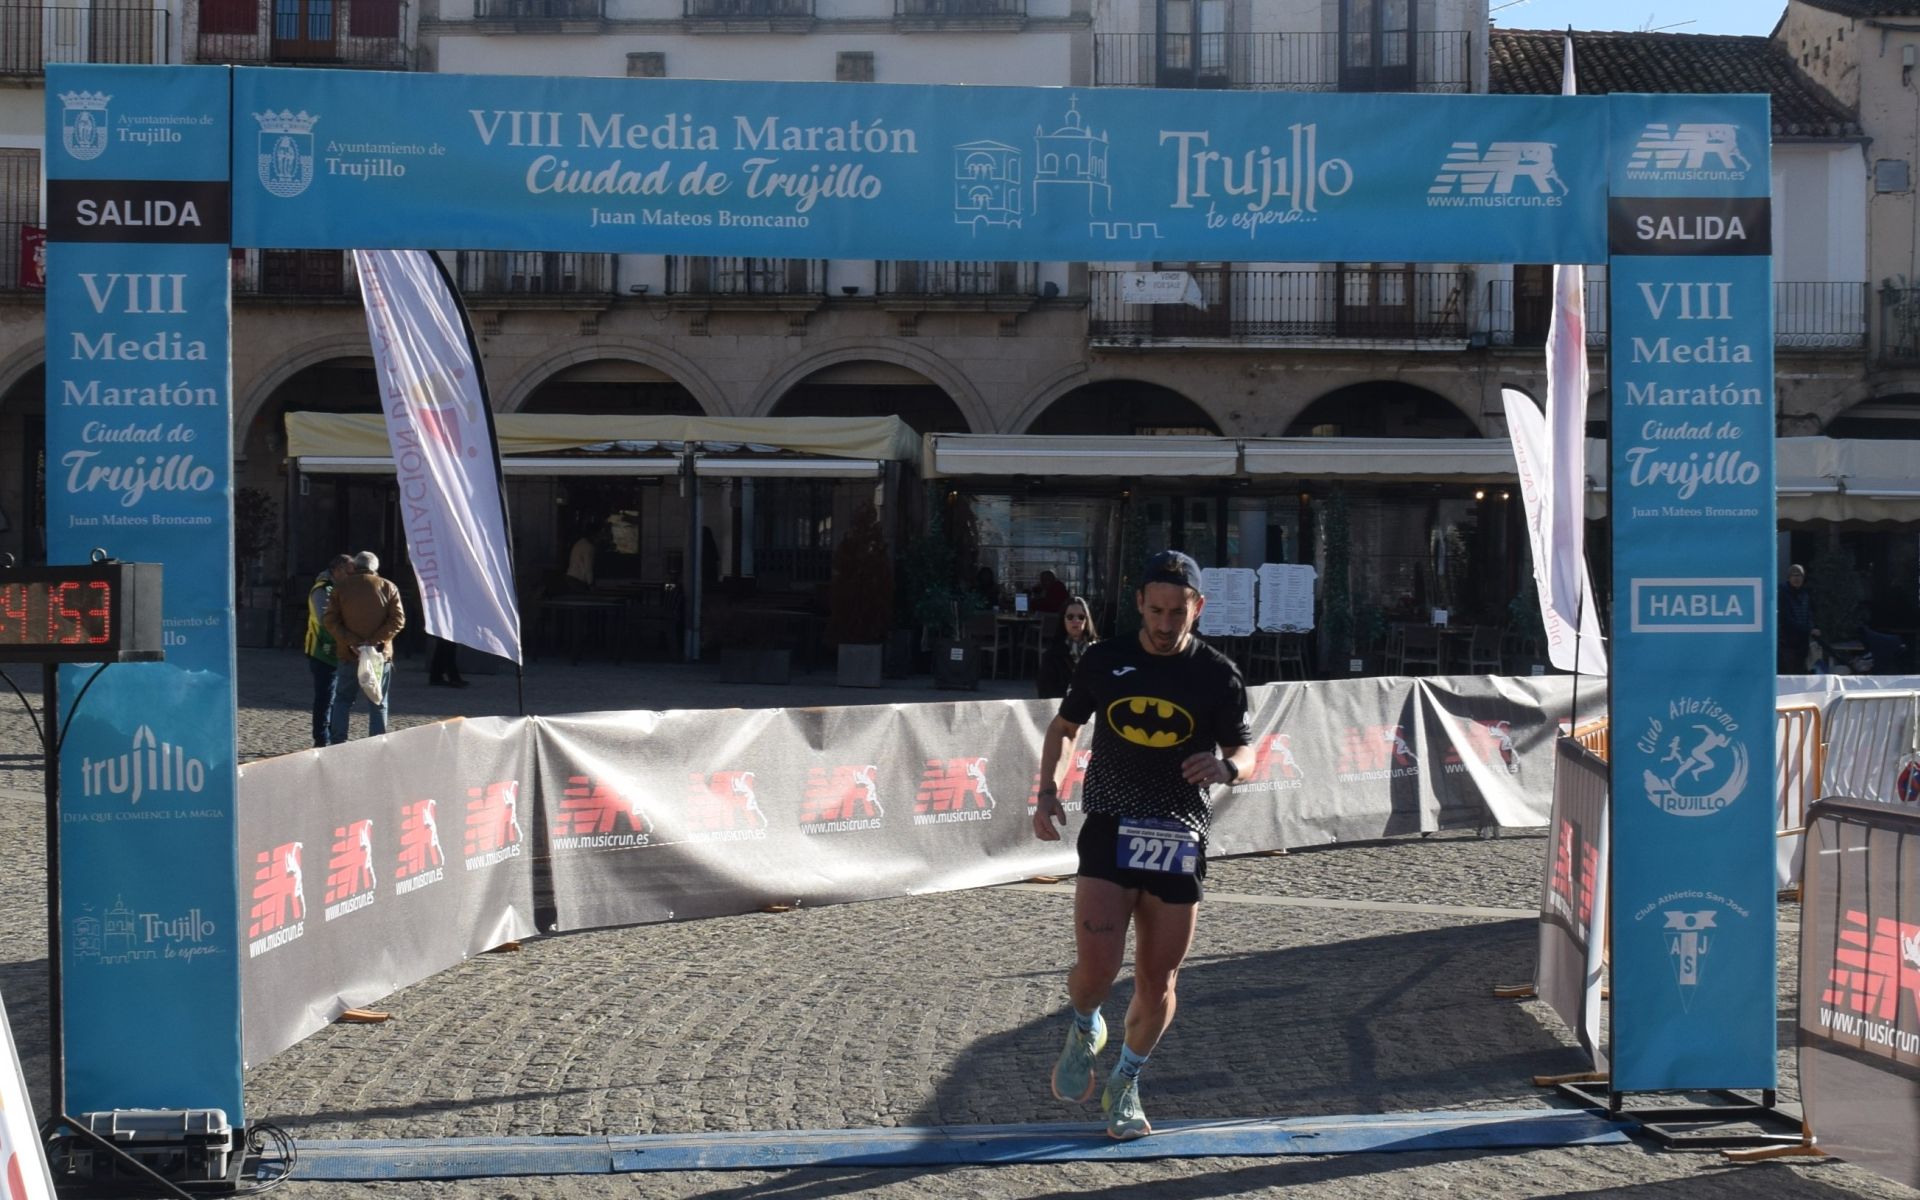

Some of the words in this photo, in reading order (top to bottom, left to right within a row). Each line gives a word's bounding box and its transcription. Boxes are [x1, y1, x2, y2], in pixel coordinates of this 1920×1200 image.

[118, 114, 197, 127] Ayuntamiento
[199, 114, 214, 125] de
[468, 109, 563, 148] VIII
[577, 112, 720, 151] Media
[733, 115, 919, 154] Maratón
[116, 127, 182, 146] Trujillo
[327, 140, 426, 156] Ayuntamiento
[428, 142, 446, 155] de
[325, 157, 406, 181] Trujillo
[1159, 122, 1354, 214] Trujillo
[1626, 169, 1745, 182] www.musicrun.es
[526, 154, 672, 196] Ciudad
[678, 161, 733, 197] de
[741, 157, 883, 213] Trujillo
[76, 199, 201, 228] SALIDA
[1426, 194, 1562, 207] www.musicrun.es
[589, 207, 636, 228] Juan
[642, 207, 712, 227] Mateos
[718, 208, 810, 228] Broncano
[1205, 200, 1228, 229] te
[1635, 215, 1747, 240] SALIDA
[77, 273, 188, 314] VIII
[1637, 282, 1733, 320] VIII
[71, 331, 208, 361] Media
[1631, 337, 1753, 364] Media
[61, 379, 219, 406] Maratón
[1624, 381, 1763, 406] Maratón
[81, 421, 163, 444] Ciudad
[167, 423, 196, 443] de
[1641, 420, 1712, 441] Ciudad
[1716, 422, 1742, 440] de
[61, 450, 215, 508] Trujillo
[1625, 446, 1760, 500] Trujillo
[68, 515, 99, 528] Juan
[102, 514, 148, 526] Mateos
[152, 514, 212, 526] Broncano
[1631, 507, 1659, 519] Juan
[1661, 506, 1702, 517] Mateos
[1705, 506, 1759, 517] Broncano
[1650, 594, 1743, 617] HABLA
[205, 615, 220, 626] de
[1637, 717, 1664, 754] Club
[1669, 696, 1739, 732] Atletismo
[82, 724, 205, 805] trujillo
[1337, 765, 1419, 783] www.musicrun.es
[174, 810, 188, 819] LA
[800, 818, 881, 836] www.musicrun.es
[913, 808, 992, 826] www.musicrun.es
[552, 832, 649, 850] www.musicrun.es
[465, 843, 521, 872] www.musicrun.es
[1128, 837, 1180, 872] 227
[396, 867, 444, 896] www.musicrun.es
[324, 889, 375, 922] www.musicrun.es
[1635, 902, 1657, 921] Club
[1658, 889, 1704, 906] Athletico
[1705, 891, 1726, 904] San
[1726, 898, 1750, 918] José
[138, 908, 216, 943] Trujillo
[249, 920, 305, 959] www.musicrun.es
[1669, 936, 1681, 955] A
[1697, 936, 1708, 954] J
[1683, 955, 1693, 974] S
[1820, 1007, 1920, 1056] www.musicrun.
